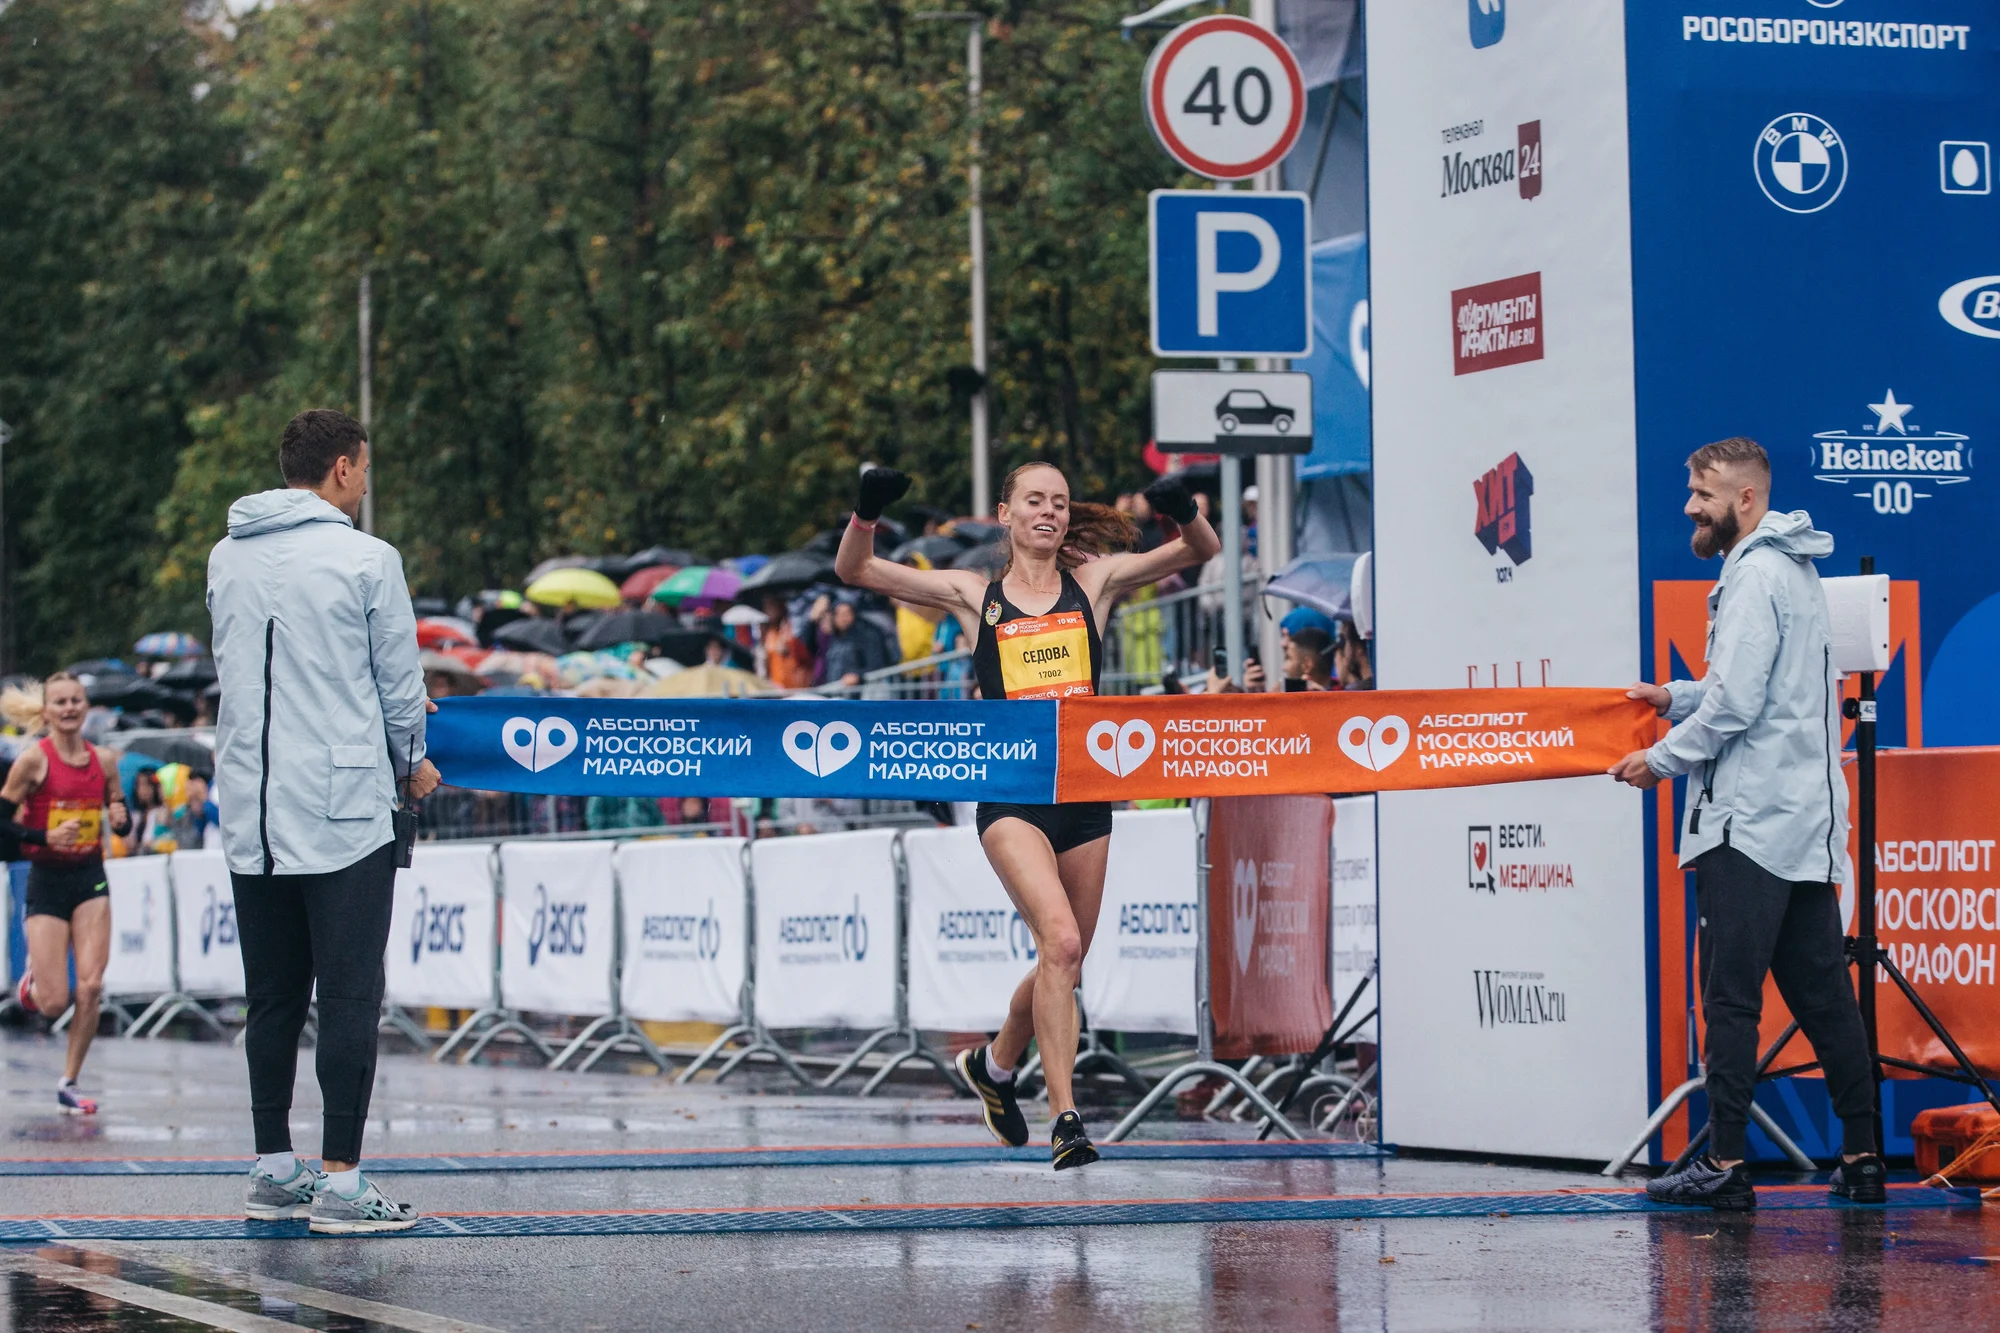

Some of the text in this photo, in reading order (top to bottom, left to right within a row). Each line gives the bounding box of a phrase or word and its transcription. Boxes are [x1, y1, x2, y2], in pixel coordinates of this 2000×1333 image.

[1683, 15, 1971, 50] РОСОБОРОНЭКСПОРТ
[1183, 66, 1272, 126] 40
[1763, 117, 1838, 149] BMW
[1441, 141, 1541, 198] Москва 24
[1820, 441, 1964, 472] Heineken
[1873, 481, 1913, 515] 0.0
[1022, 645, 1070, 665] СЕДОВА
[1038, 669, 1062, 679] 17002
[1073, 685, 1089, 694] asics
[586, 718, 700, 732] АБСОЛЮТ
[870, 722, 986, 737] АБСОЛЮТ
[1163, 719, 1267, 733] АБСОЛЮТ
[1418, 712, 1528, 728] АБСОЛЮТ
[585, 734, 752, 756] МОСКОВСКИЙ
[869, 738, 1037, 760] МОСКОВСКИЙ
[1162, 733, 1311, 757] МОСКОВСКИЙ
[1416, 726, 1575, 751] МОСКОВСКИЙ
[583, 757, 701, 776] МАРАФОН
[1163, 760, 1269, 778] МАРАФОН
[1419, 751, 1535, 769] МАРАФОН
[868, 763, 987, 781] МАРАФОН
[1500, 864, 1574, 893] МЕДИЦИНА
[1874, 888, 2000, 931] ОСКОВС
